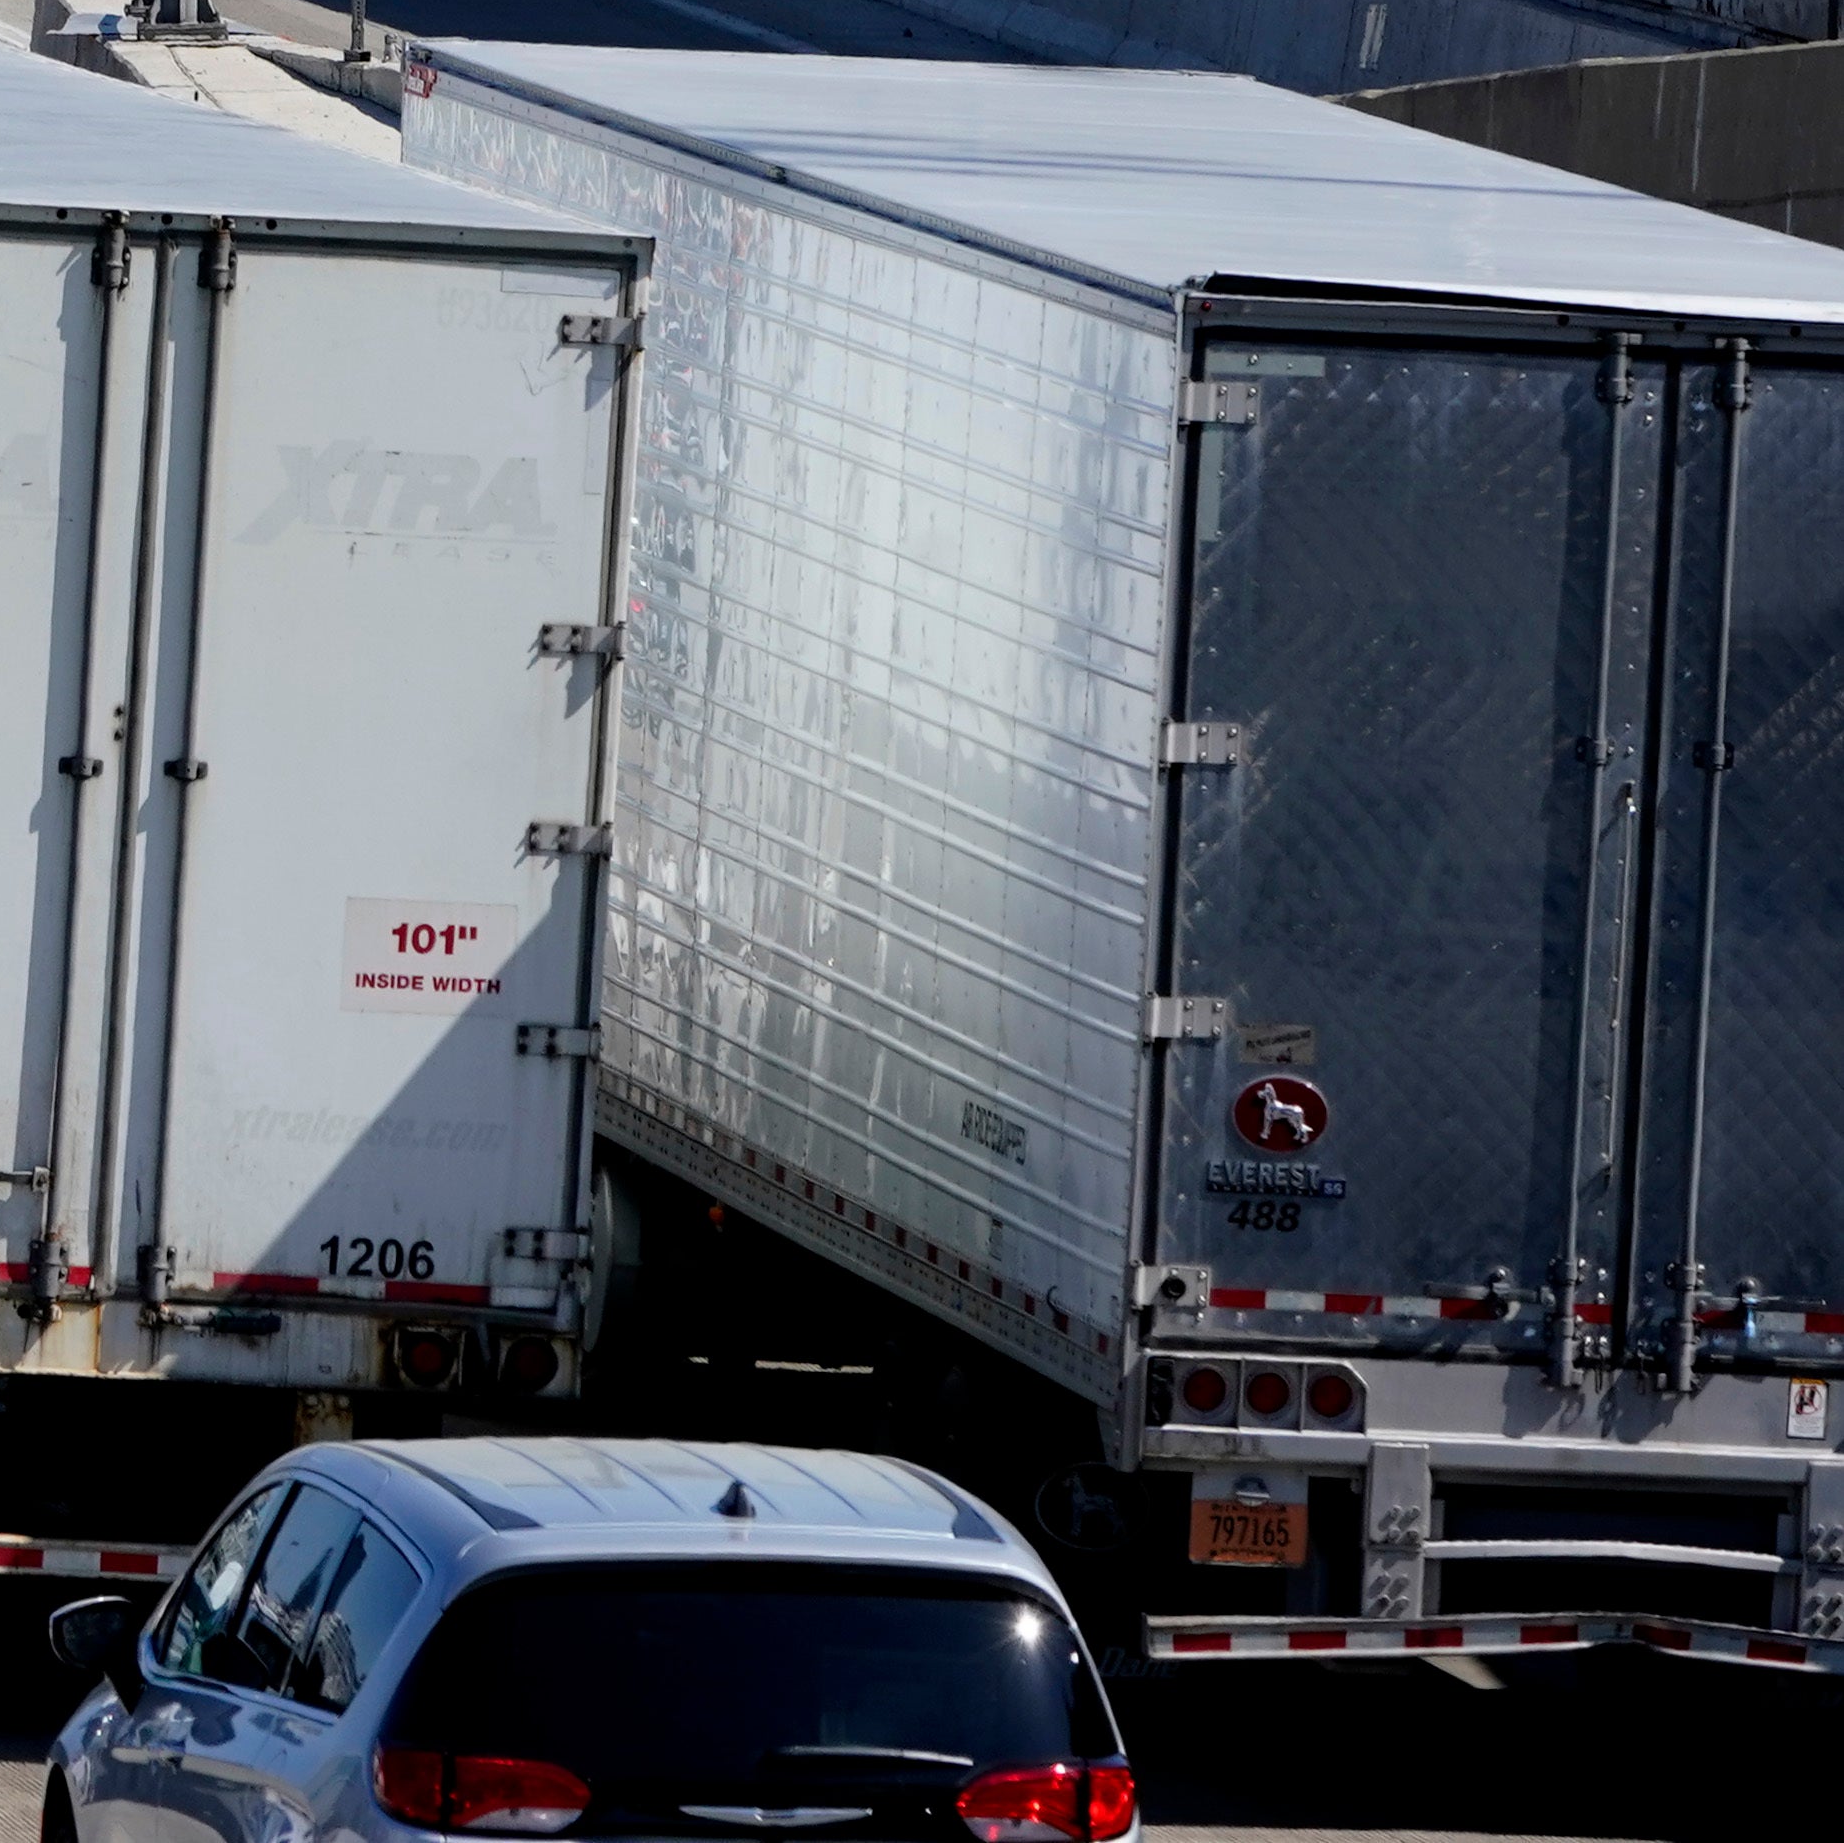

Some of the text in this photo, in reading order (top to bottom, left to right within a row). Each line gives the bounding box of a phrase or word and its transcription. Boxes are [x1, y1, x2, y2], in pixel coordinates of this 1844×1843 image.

[231, 437, 559, 547] XTRA
[390, 922, 478, 956] 101"
[353, 972, 502, 996] INSIDE WIDTH
[1207, 1159, 1321, 1188] EVEREST
[1227, 1199, 1302, 1233] 488
[318, 1235, 435, 1280] 1206
[1209, 1515, 1291, 1547] 797165
